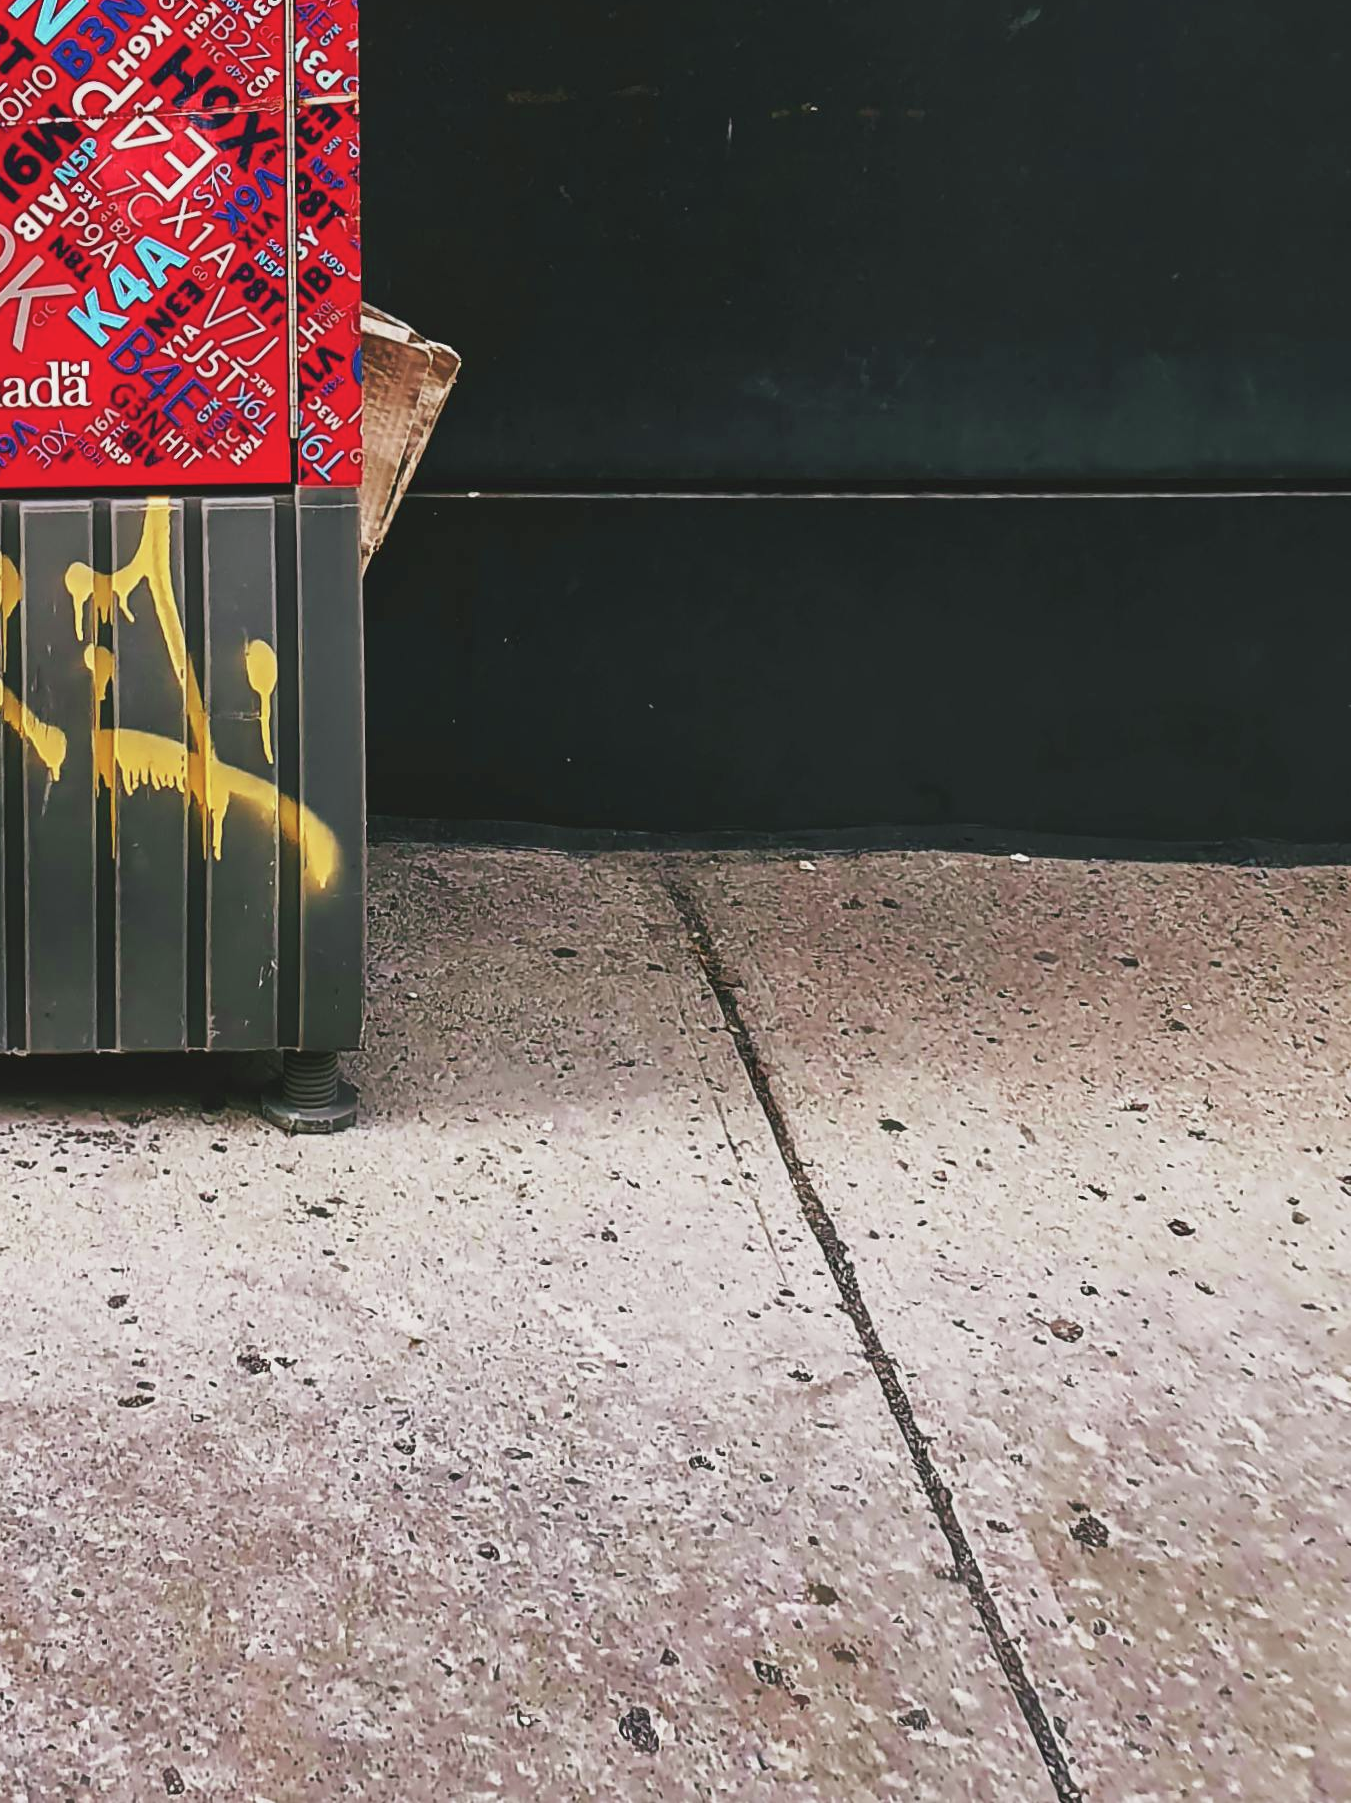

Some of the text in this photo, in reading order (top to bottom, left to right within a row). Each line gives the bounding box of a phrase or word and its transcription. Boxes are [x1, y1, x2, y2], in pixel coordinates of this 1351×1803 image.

[183, 1, 223, 40] K6H
[319, 23, 343, 47] G7K
[107, 15, 174, 80] K6H
[199, 38, 226, 64] T1C
[210, 15, 272, 74] B2Z
[225, 63, 248, 85] E4P
[53, 137, 97, 186] N5P
[323, 135, 343, 156] S4N
[70, 181, 103, 211] P3Y
[87, 153, 164, 227] L7C
[192, 163, 233, 209] S7P
[213, 167, 285, 235] V6K
[13, 182, 69, 242] A1B
[109, 217, 137, 244] B2J
[59, 205, 119, 269] P9A
[159, 197, 237, 279] X1A
[253, 250, 286, 278] N5P
[318, 249, 346, 276] G6X
[67, 235, 191, 348] K4A
[145, 279, 205, 338] E3N
[230, 262, 285, 314] P8T
[160, 324, 201, 359] Y1A
[203, 286, 280, 367] V7J
[109, 326, 212, 427] B4E
[183, 339, 249, 392] J5T
[250, 373, 277, 398] M3C
[196, 397, 223, 423] G7K
[228, 381, 277, 435] T9K
[307, 396, 344, 431] M3C
[99, 436, 132, 465] N5P
[159, 428, 203, 469] H1T
[207, 427, 242, 459] T1C
[230, 433, 263, 466] T4H
